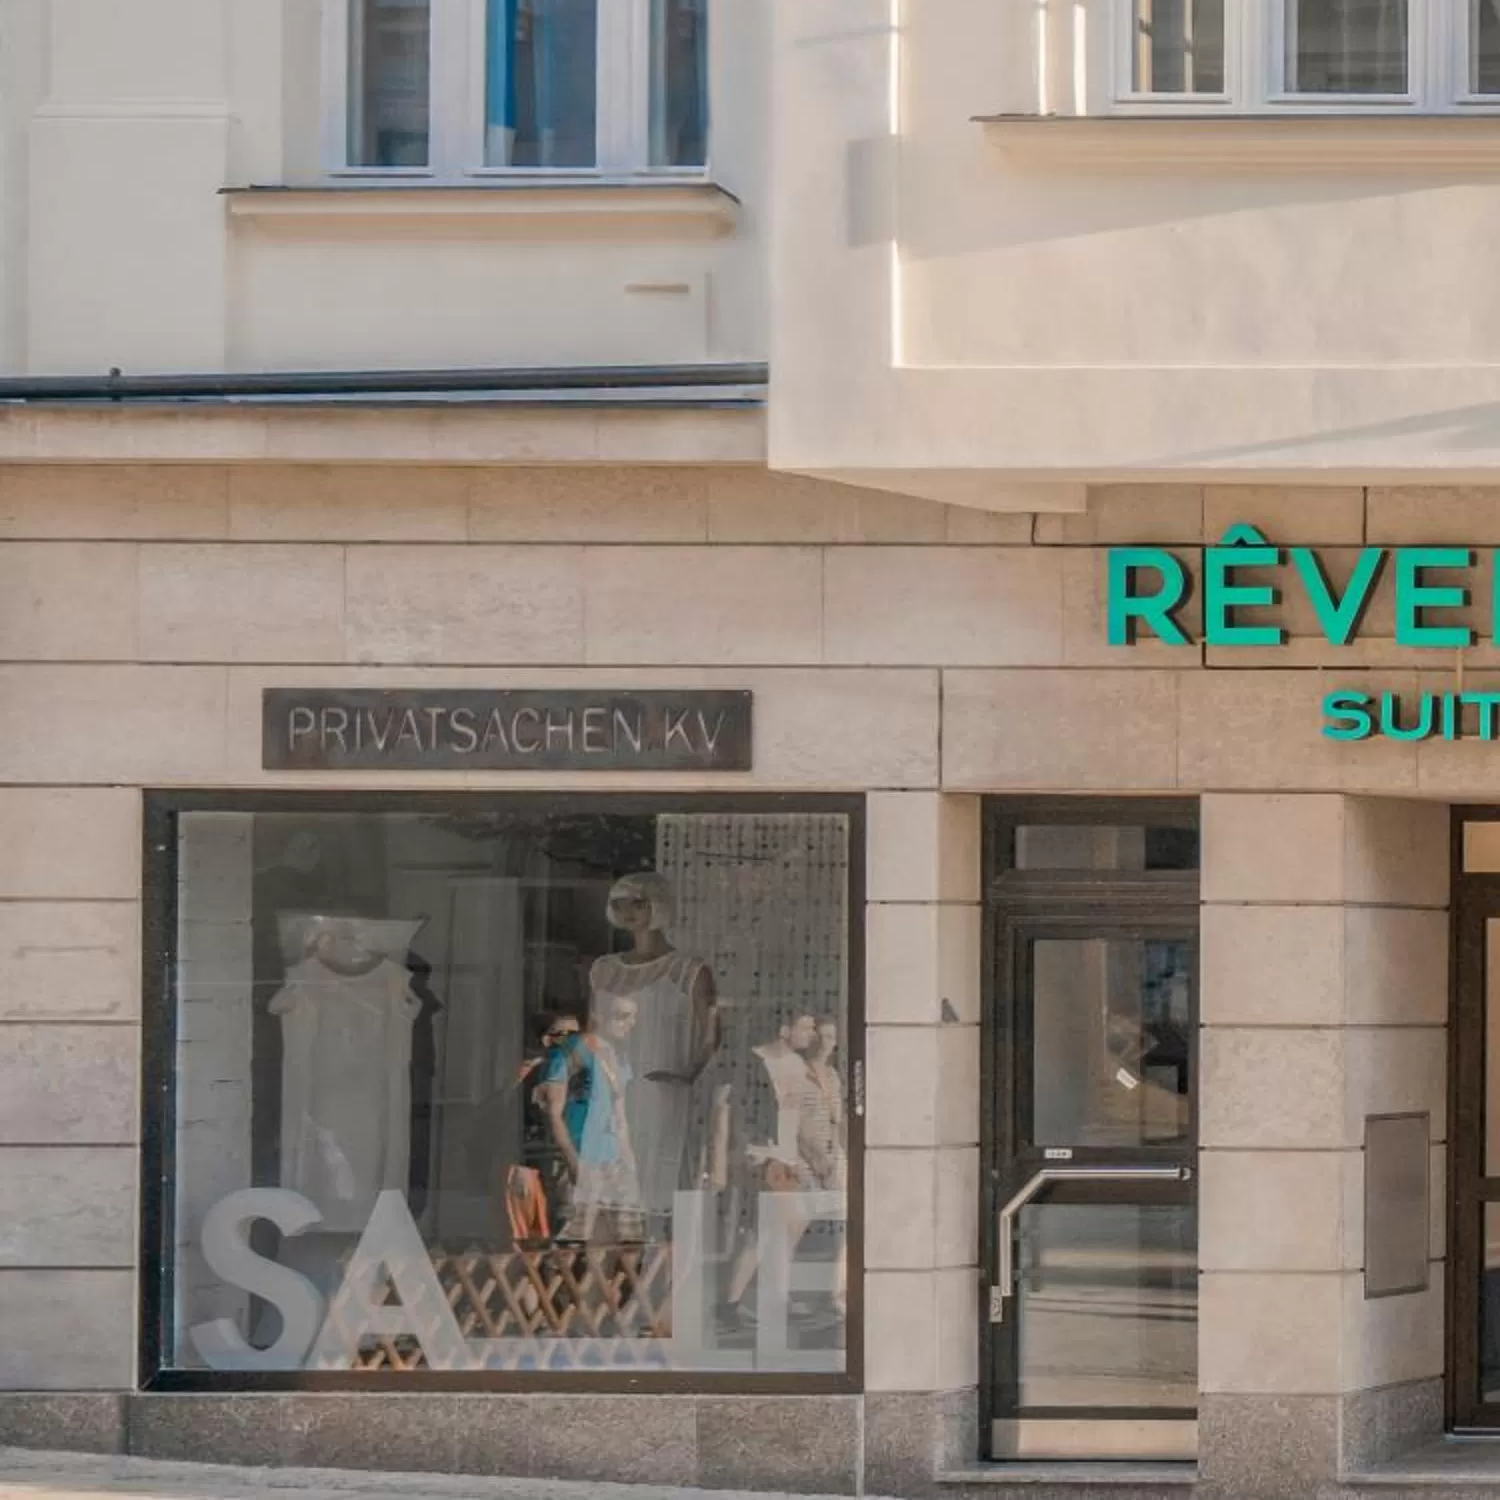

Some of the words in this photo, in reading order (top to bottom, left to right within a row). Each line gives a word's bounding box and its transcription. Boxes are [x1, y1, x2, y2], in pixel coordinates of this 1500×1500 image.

[288, 706, 642, 754] PRIVATSACHEN
[663, 706, 727, 755] KV
[190, 1186, 848, 1370] SALE
